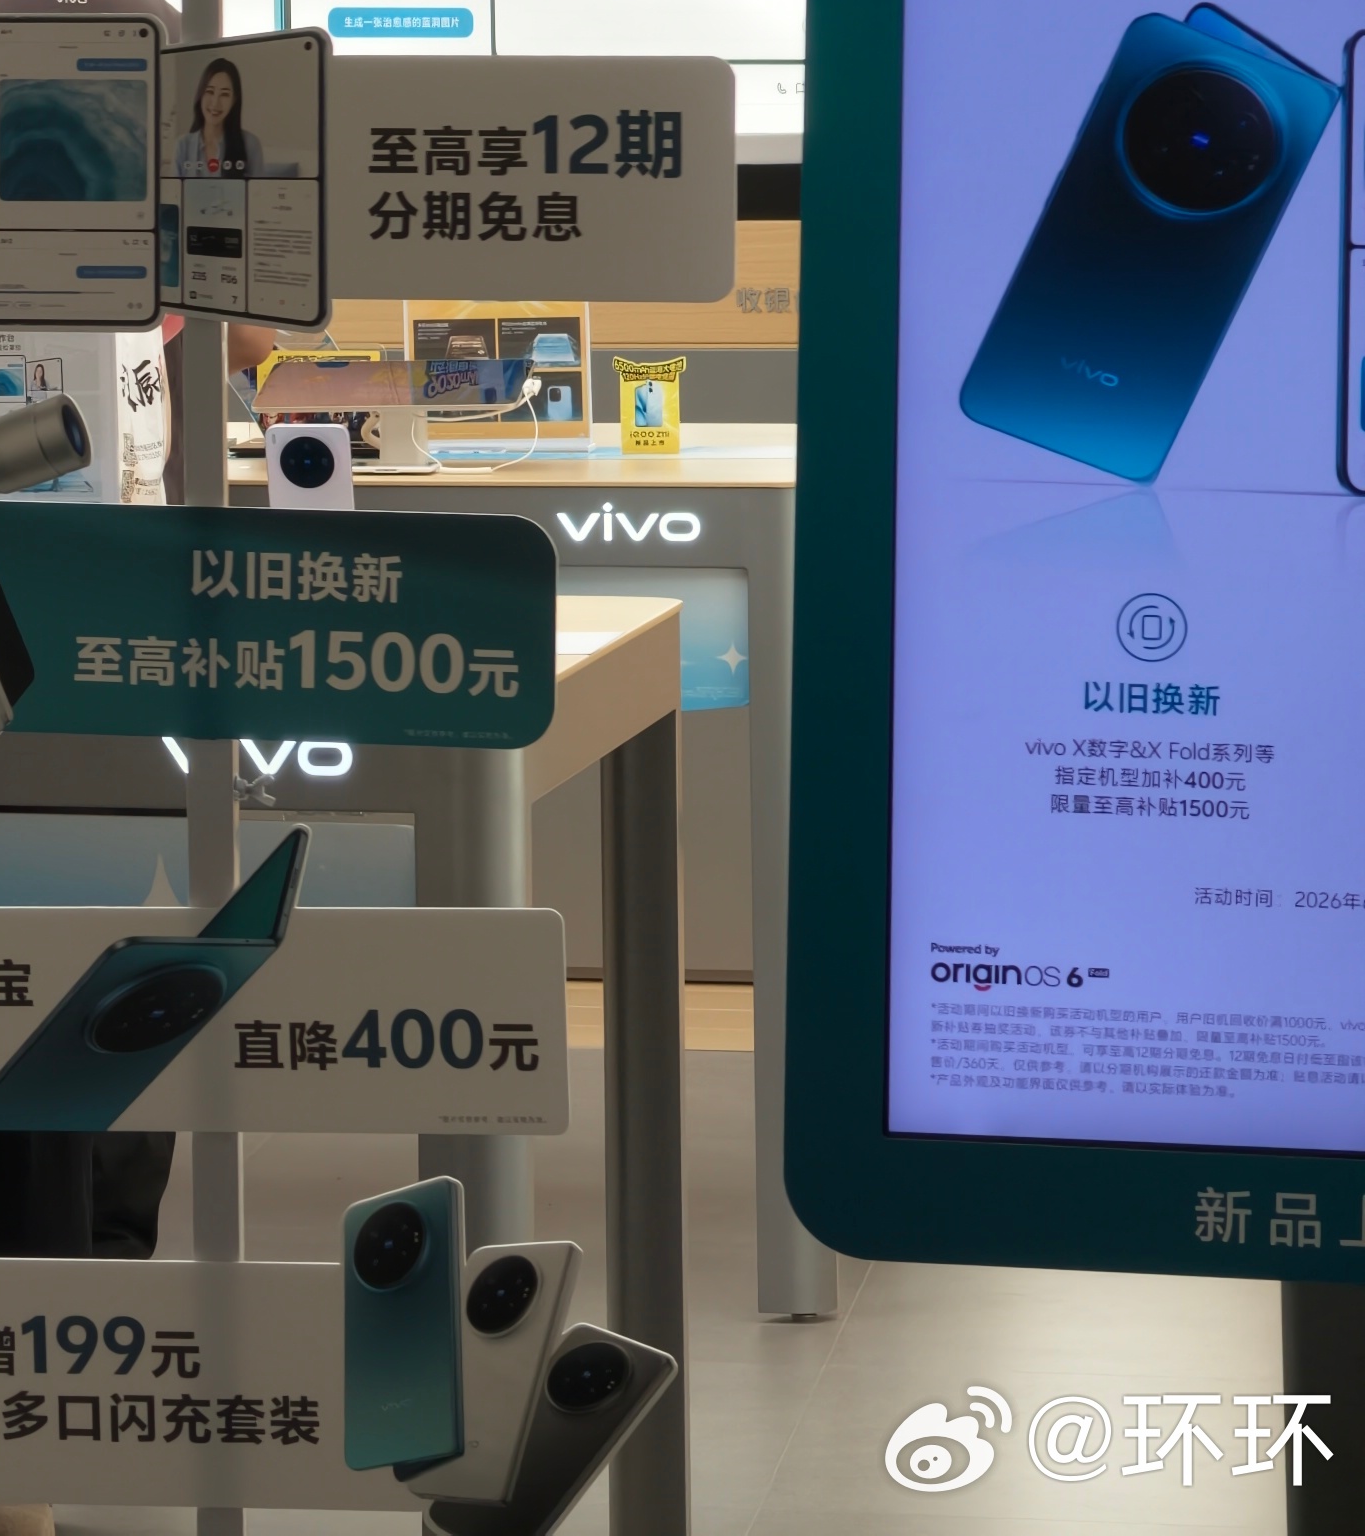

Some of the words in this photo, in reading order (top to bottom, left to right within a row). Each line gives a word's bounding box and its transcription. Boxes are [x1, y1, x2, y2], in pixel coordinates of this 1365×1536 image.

[368, 109, 683, 180] 至高享12期
[368, 191, 582, 244] 分期免息
[736, 287, 800, 314] 收银
[1061, 355, 1119, 387] vivo
[556, 502, 701, 542] vivo
[191, 550, 402, 604] 以旧换新
[73, 629, 519, 698] 至高补贴1500元
[1083, 681, 1221, 716] 以旧换新
[1025, 738, 1066, 756] vivo
[1072, 739, 1162, 760] X数字&X
[1169, 742, 1275, 764] Fold系列等
[1054, 766, 1247, 792] 指定机型加补400元
[1050, 794, 1250, 820] 限量至高补贴1500元
[930, 942, 981, 955] Powered
[984, 944, 1000, 957] by
[1066, 967, 1084, 988] 6
[234, 1008, 540, 1073] 直降400元
